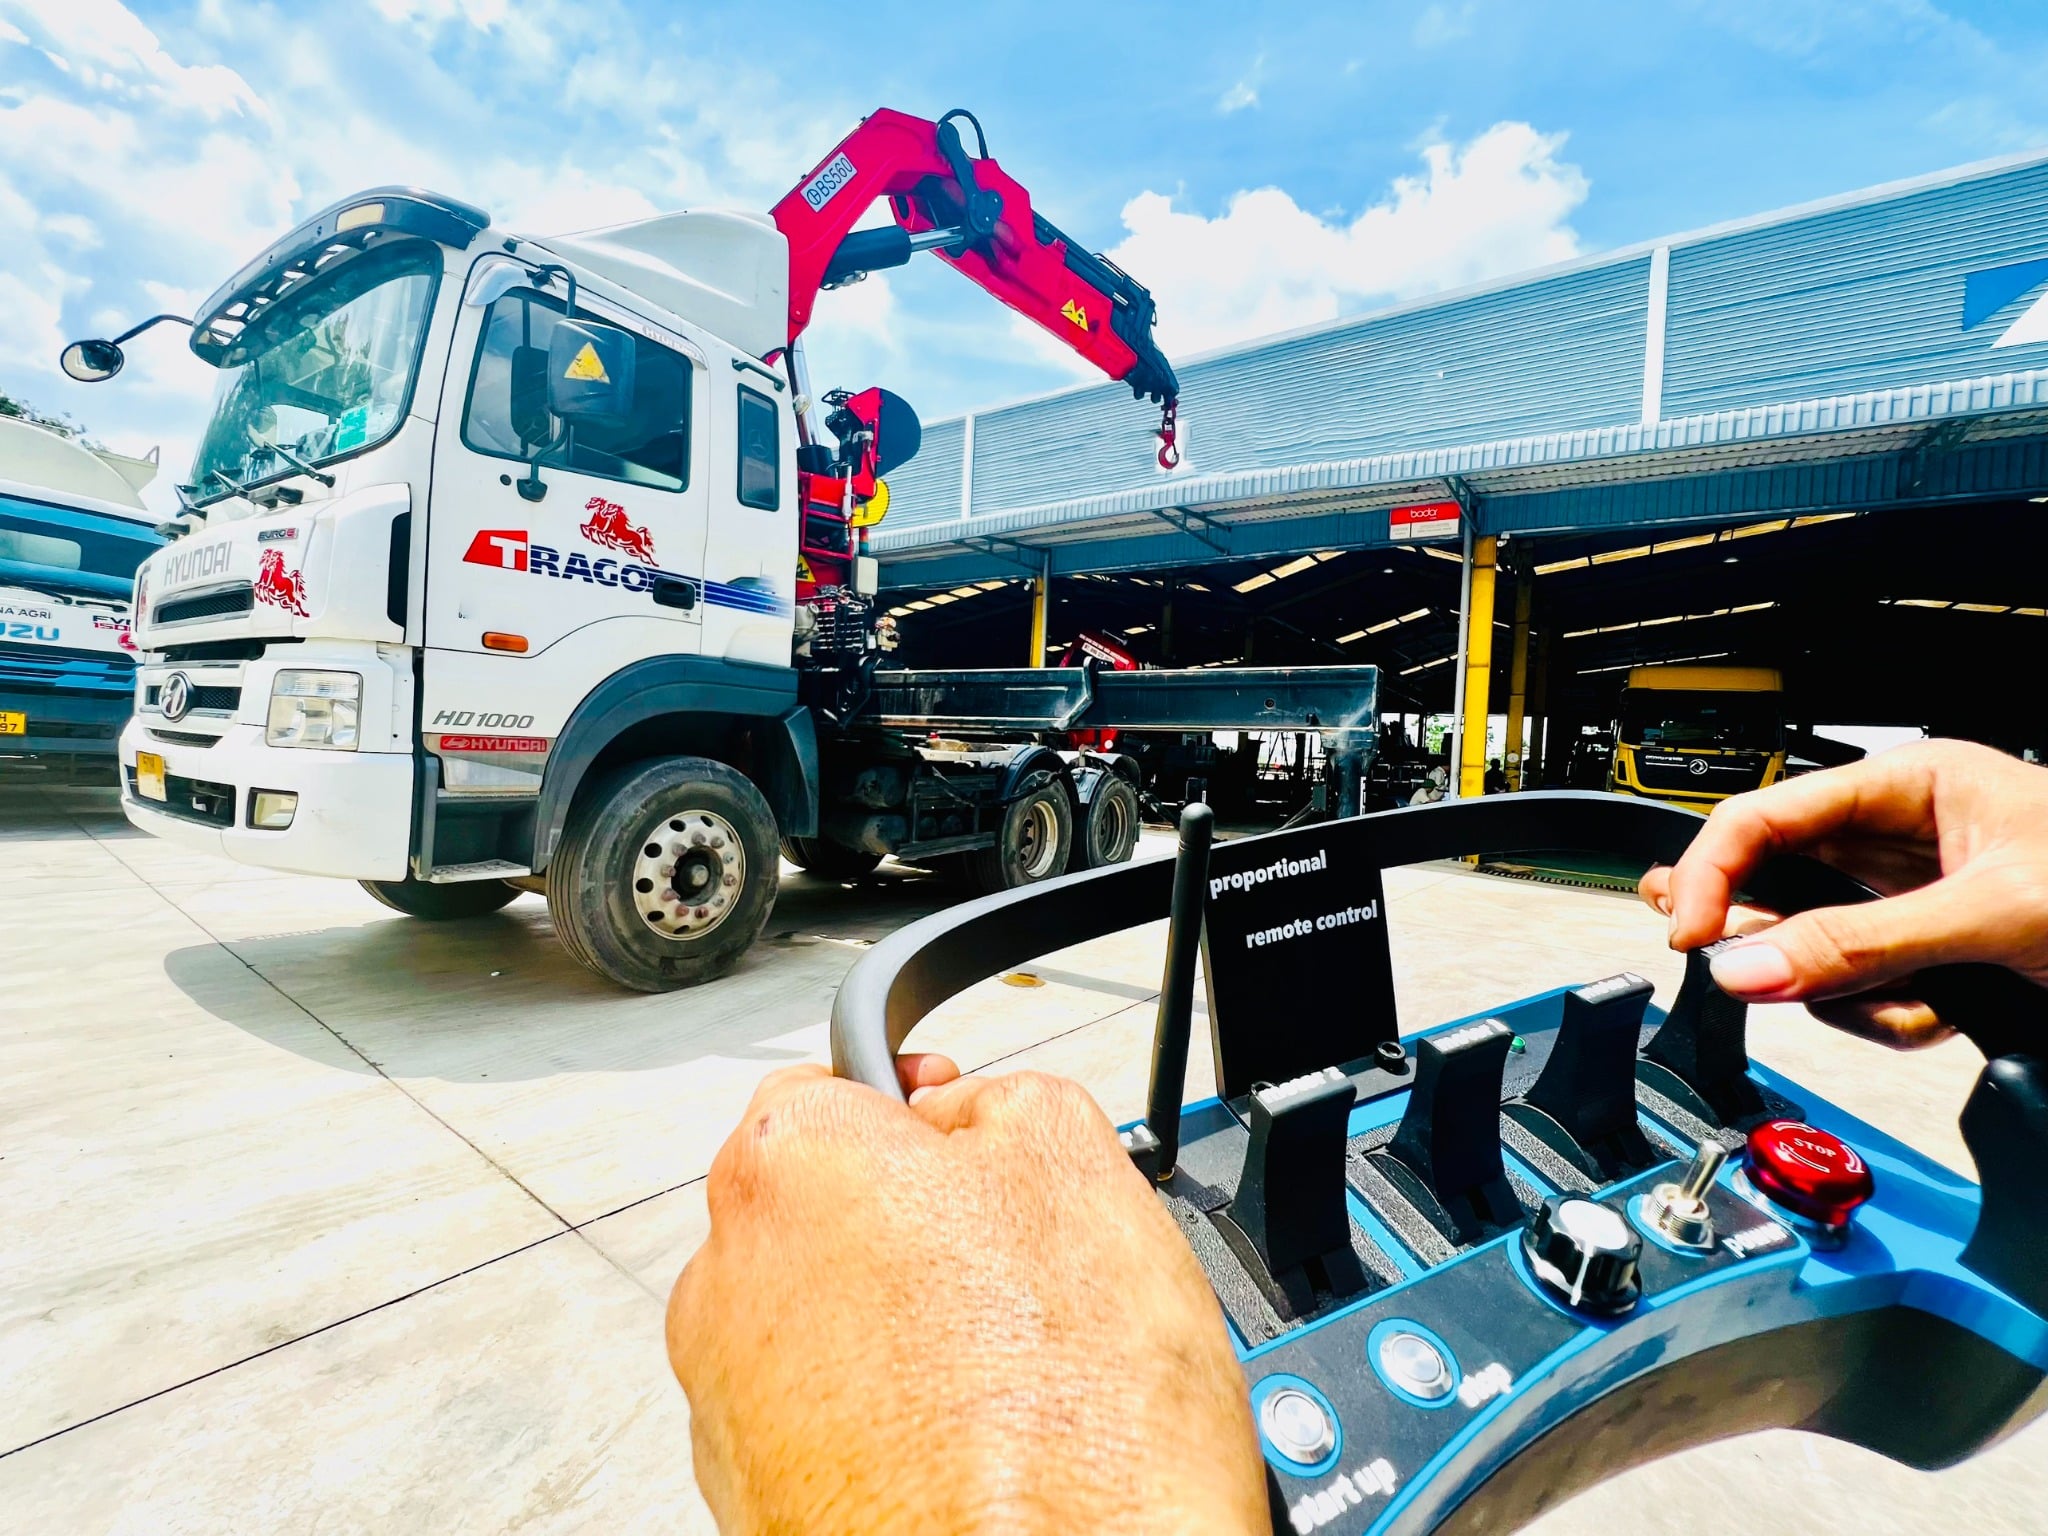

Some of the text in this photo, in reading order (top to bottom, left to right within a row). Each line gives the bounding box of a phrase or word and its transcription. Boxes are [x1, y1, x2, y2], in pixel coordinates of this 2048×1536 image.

[815, 157, 853, 198] BS560
[164, 541, 233, 587] HYUNDAI
[18, 609, 51, 619] AGRI
[0, 622, 59, 641] ZU
[94, 622, 131, 631] 150
[470, 738, 546, 752] HYUNDAI
[1209, 849, 1328, 900] proportional
[1246, 899, 1378, 949] remote control
[1793, 1137, 1837, 1158] STOP
